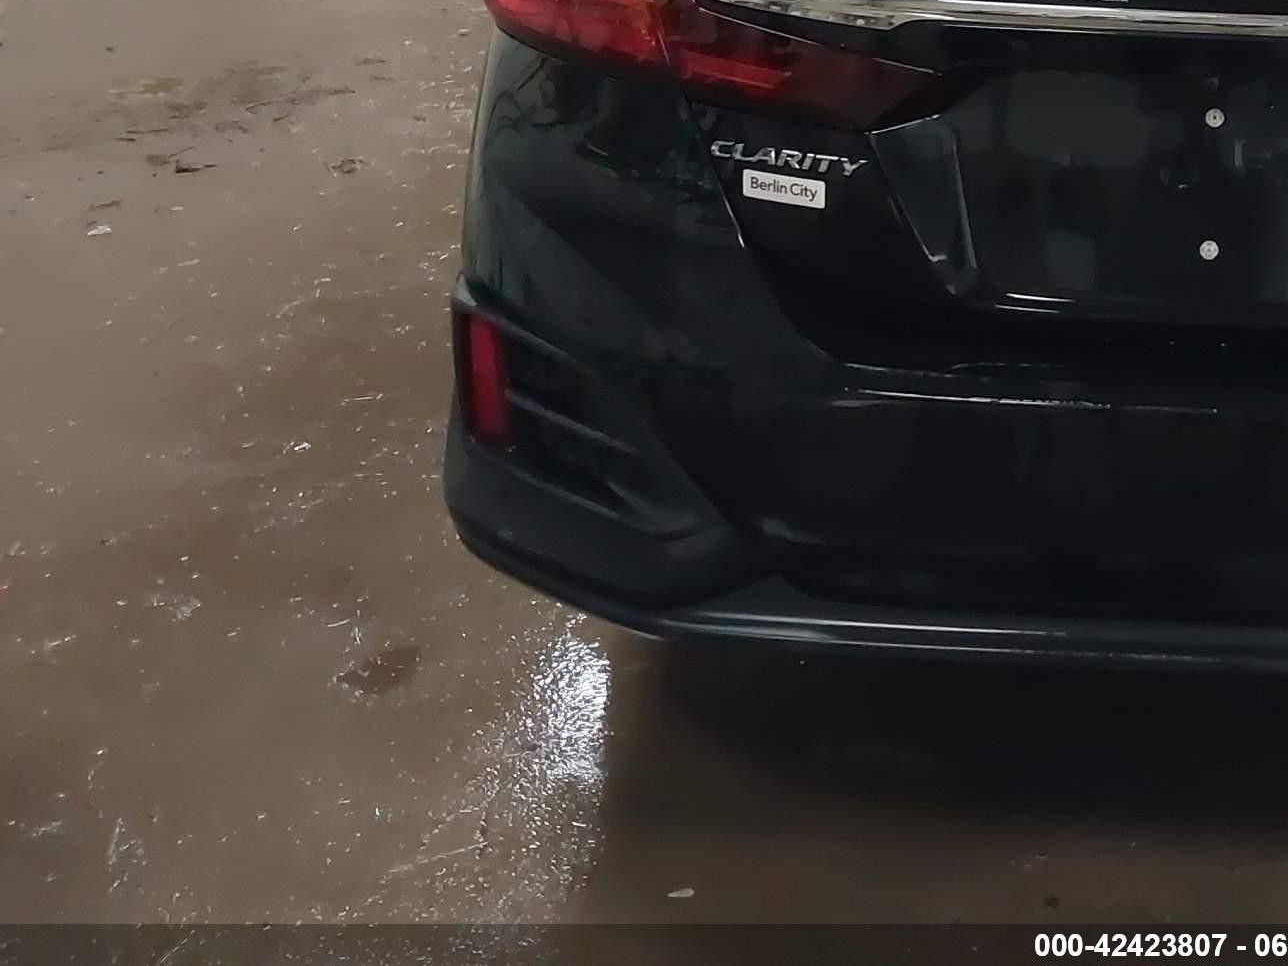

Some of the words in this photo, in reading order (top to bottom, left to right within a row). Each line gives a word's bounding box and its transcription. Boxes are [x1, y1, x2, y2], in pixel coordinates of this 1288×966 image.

[710, 140, 869, 176] CLARITY
[750, 177, 788, 195] Berlin
[789, 182, 818, 202] City
